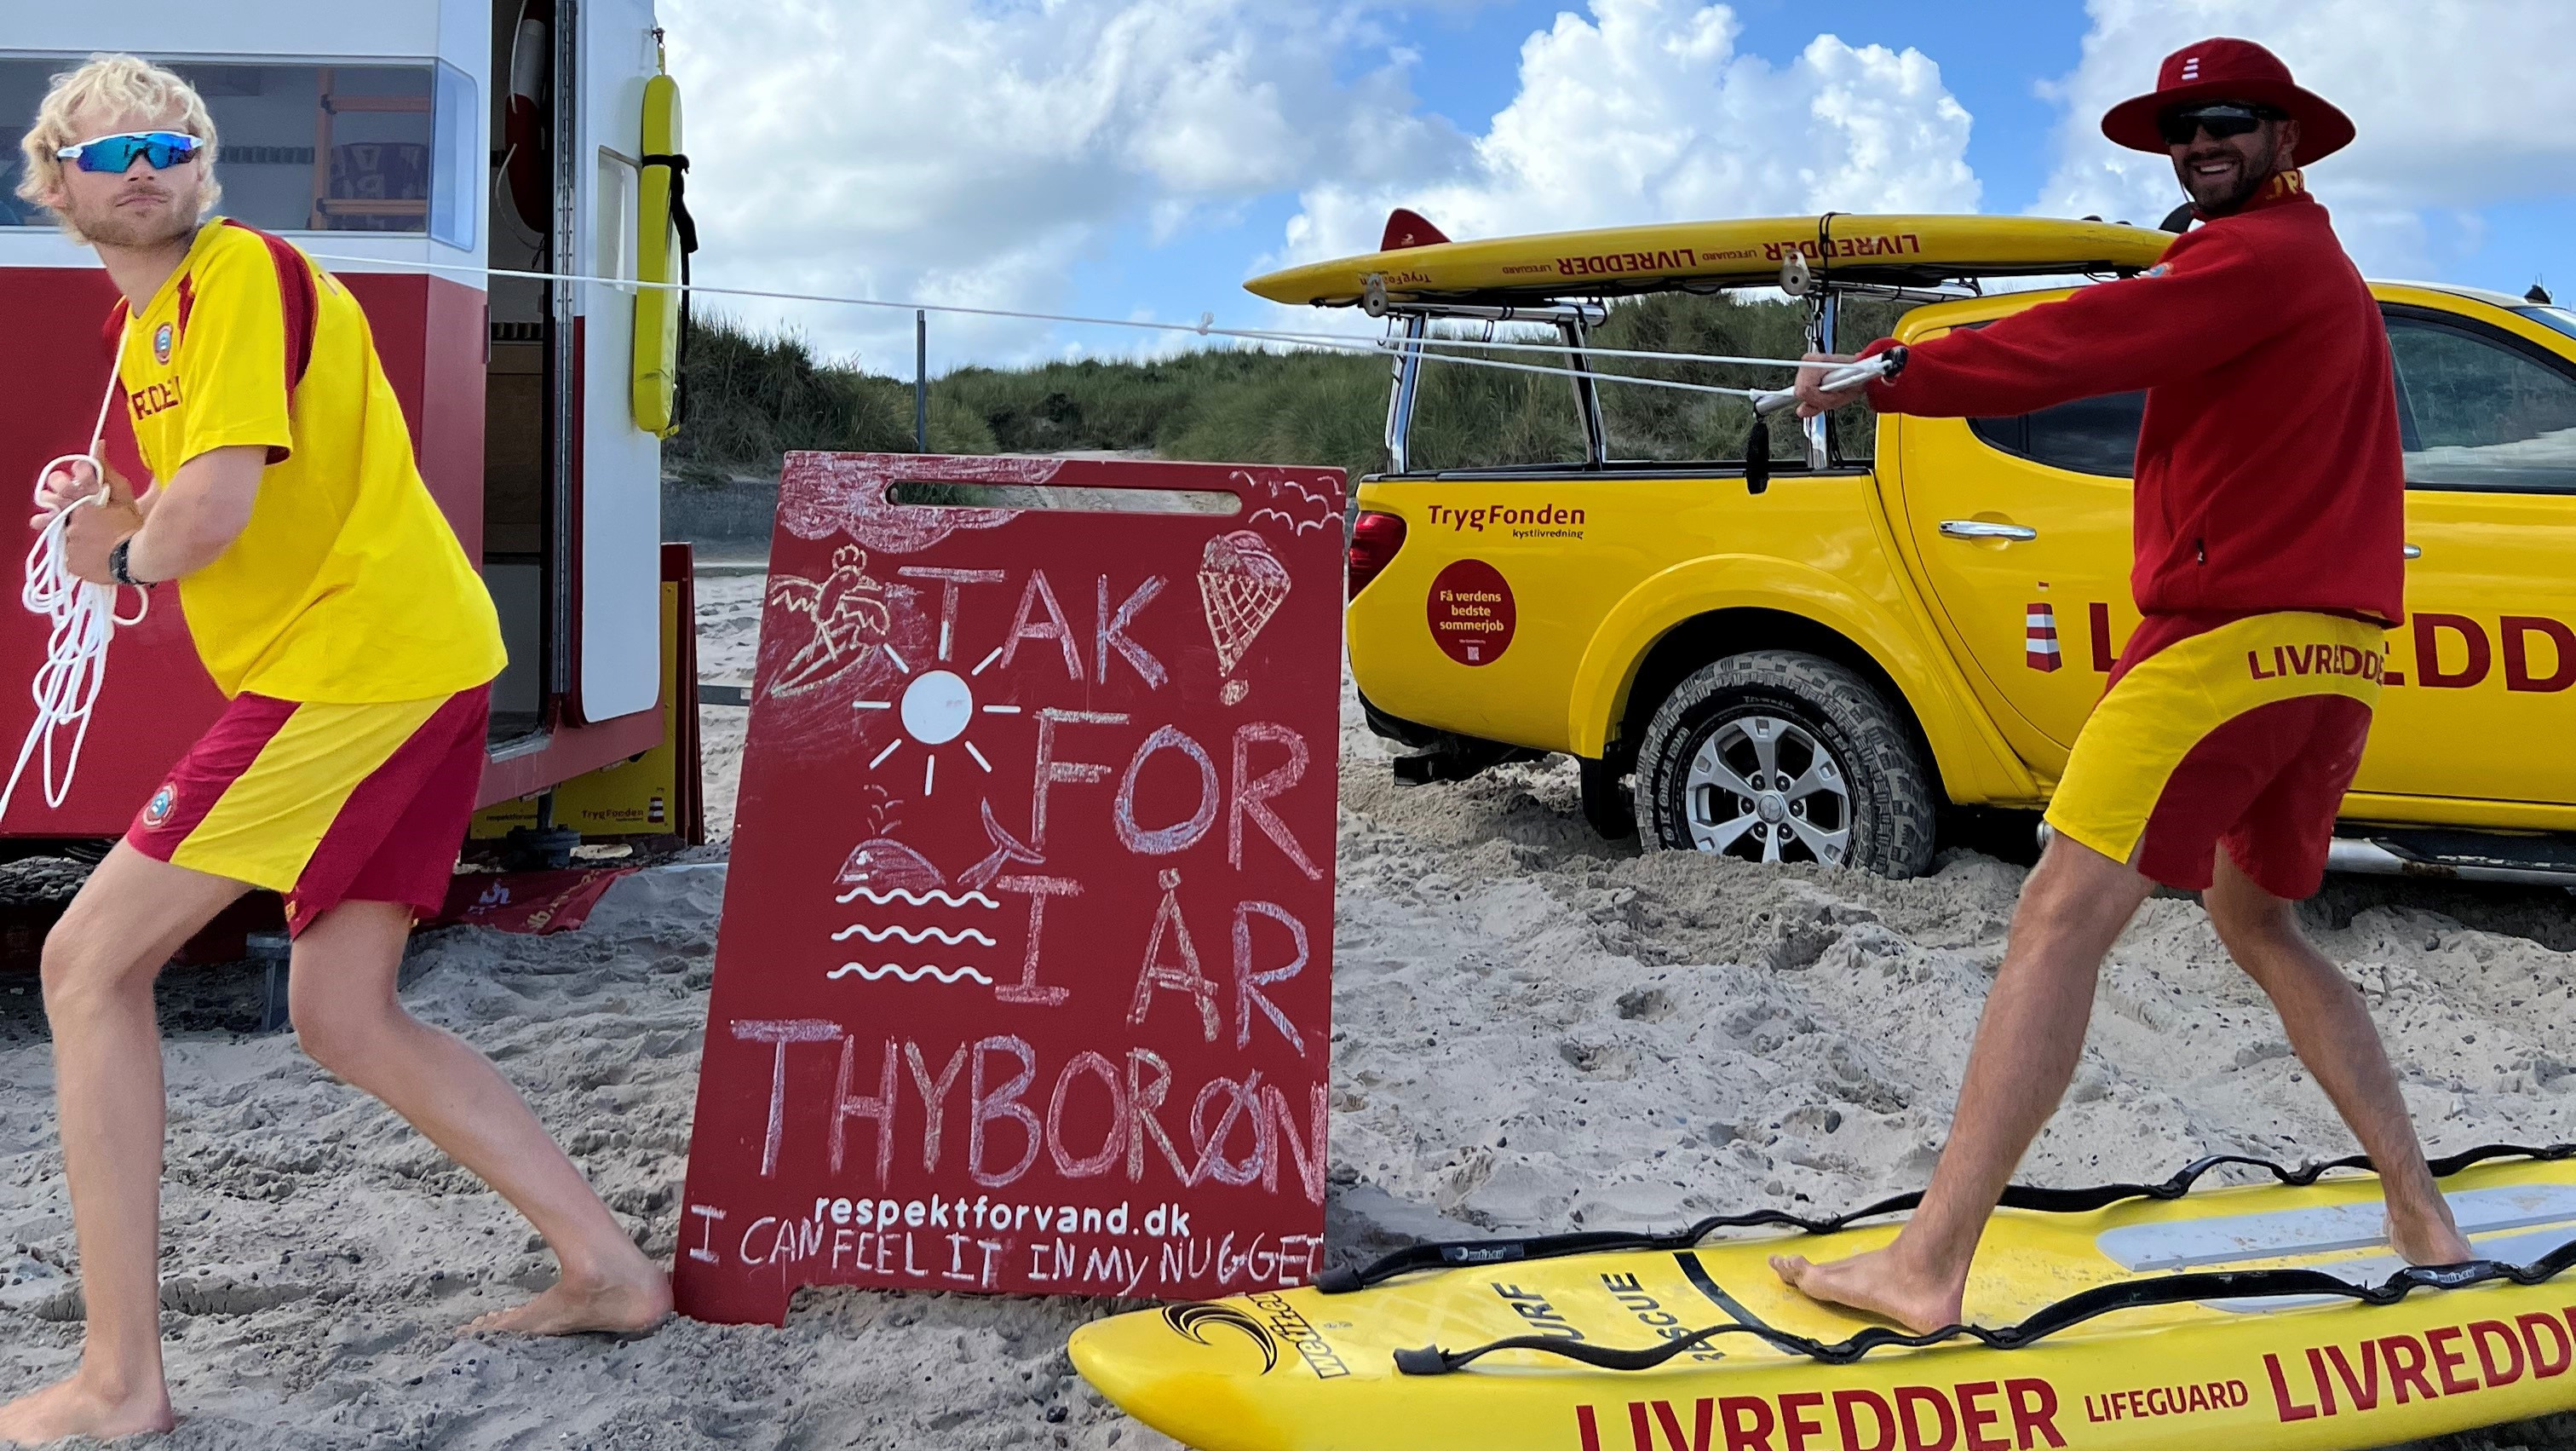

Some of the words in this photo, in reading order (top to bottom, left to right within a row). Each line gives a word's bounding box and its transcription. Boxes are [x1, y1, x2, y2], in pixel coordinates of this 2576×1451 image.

[1502, 264, 1552, 274] LIFEGUARD
[1556, 248, 1697, 275] LIVREDDER
[1702, 249, 1758, 261] LIFEGUARD
[1428, 504, 1585, 532] TrygFonden
[1512, 529, 1584, 539] kystlivredning
[1440, 590, 1453, 602] Få
[1456, 590, 1502, 602] verdens
[1451, 604, 1492, 616] bedste
[1440, 619, 1504, 633] sommerjob
[1031, 707, 1324, 880] FOR
[995, 875, 1084, 1005] I
[1127, 868, 1309, 1057] ÅR
[730, 1018, 1328, 1206] THYBORØN
[814, 1195, 1190, 1235] respektforvand.dk
[689, 1204, 727, 1264] I
[739, 1216, 823, 1265] CAN
[832, 1227, 929, 1275] FEEL
[941, 1233, 1003, 1287] IT
[1028, 1237, 1075, 1281] IN
[1491, 1282, 1584, 1340] URF
[2084, 1379, 2249, 1423] LIFEGUARD
[2263, 1306, 2576, 1423] LIVREDD
